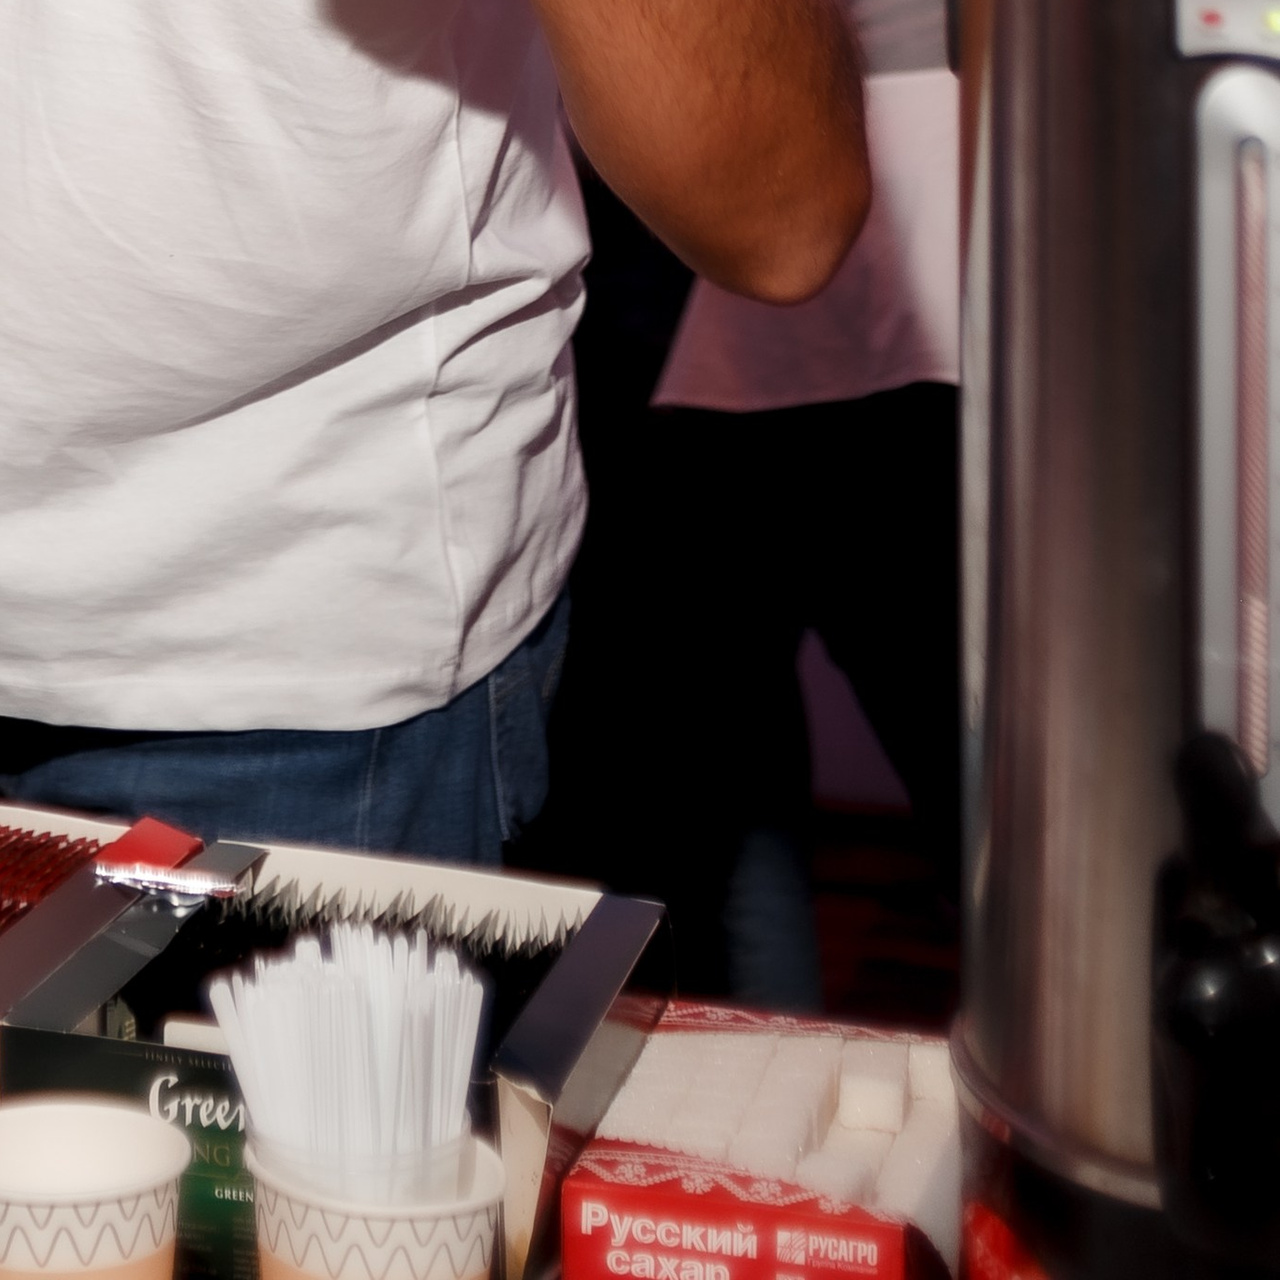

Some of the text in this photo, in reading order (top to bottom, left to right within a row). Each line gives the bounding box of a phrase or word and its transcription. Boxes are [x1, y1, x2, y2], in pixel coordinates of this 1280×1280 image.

[215, 1187, 254, 1203] GREEN
[580, 1200, 758, 1260] Русский
[808, 1235, 878, 1267] РУСАГРО
